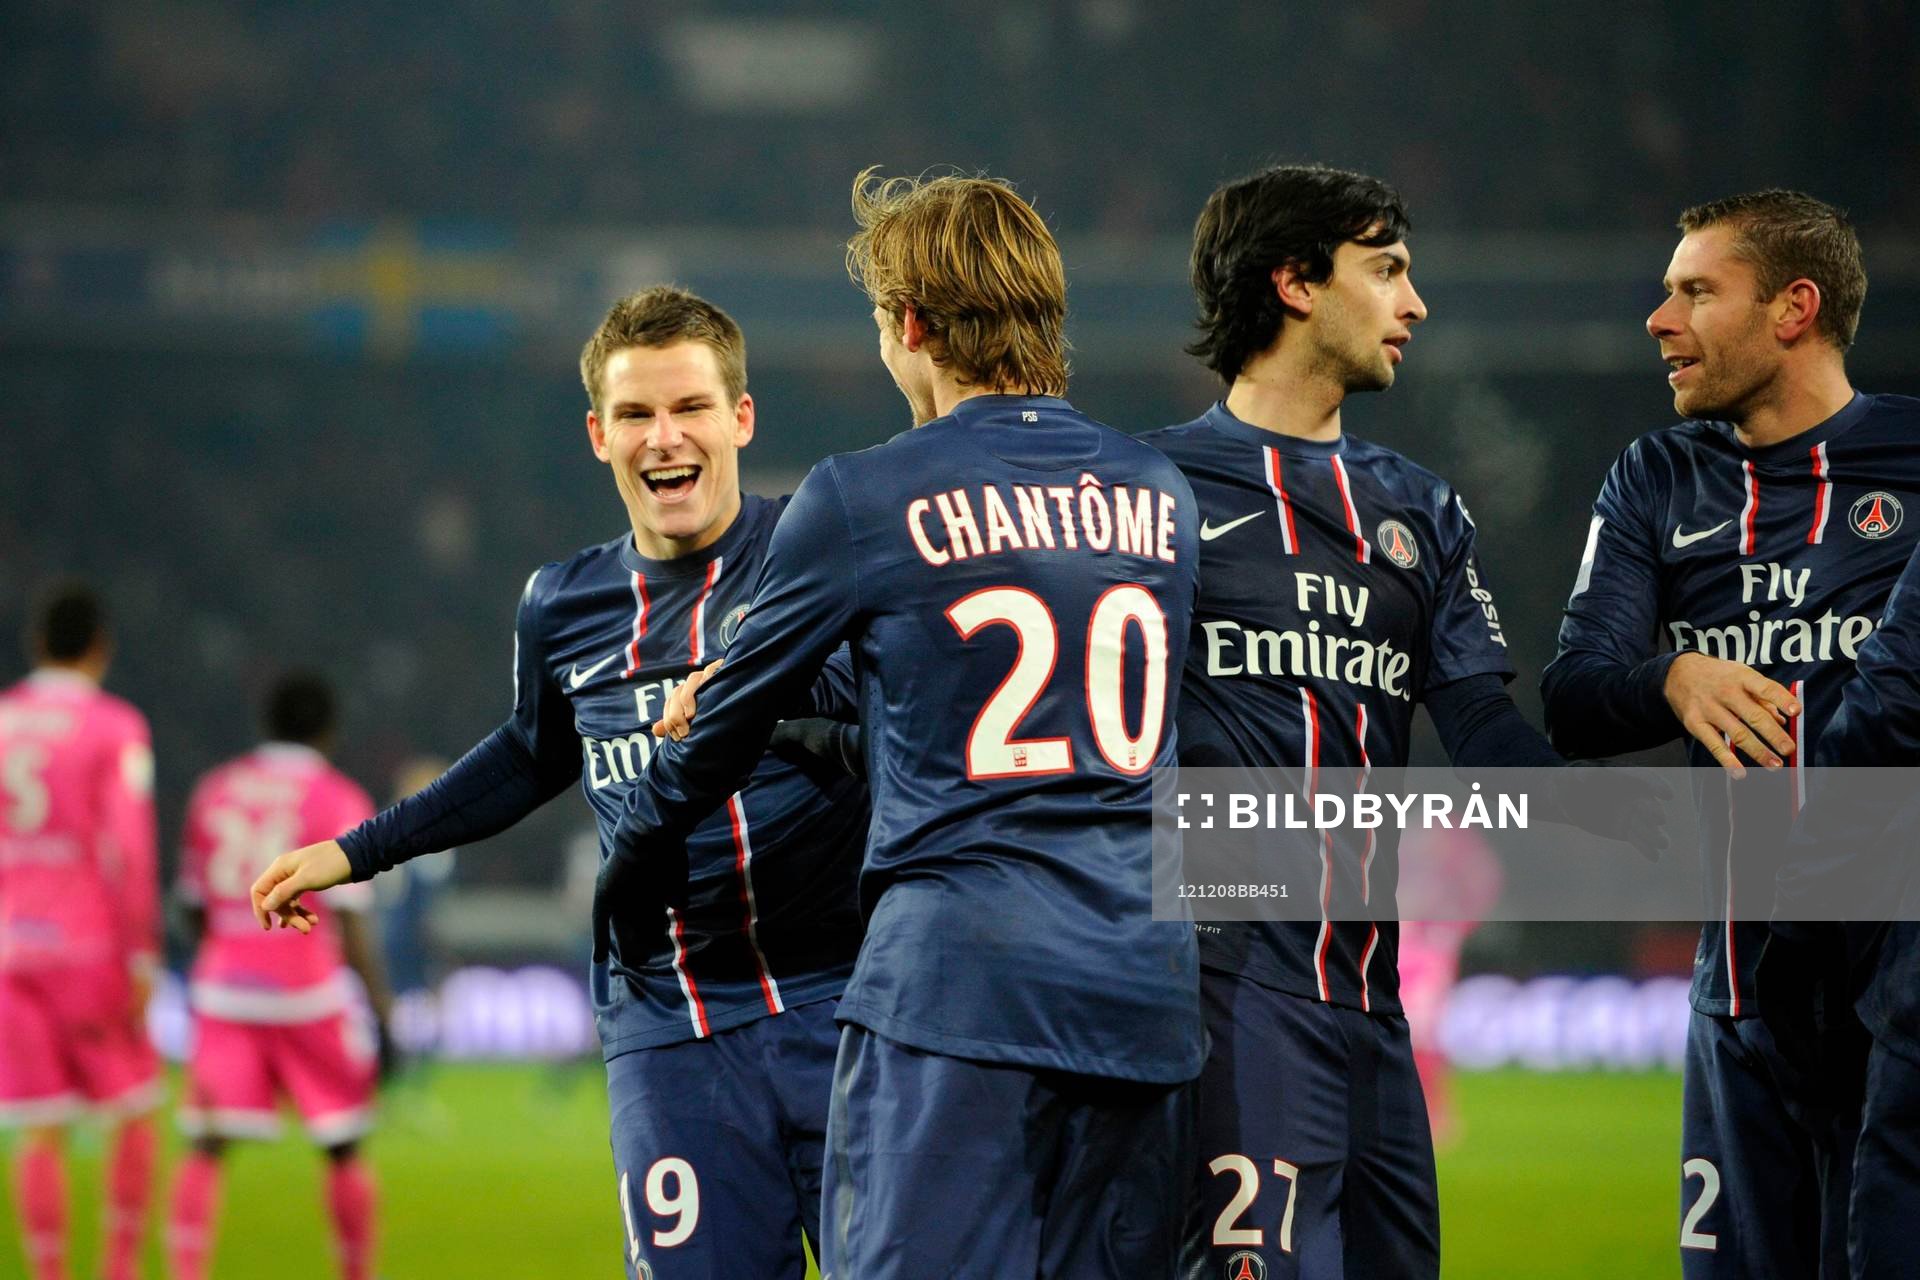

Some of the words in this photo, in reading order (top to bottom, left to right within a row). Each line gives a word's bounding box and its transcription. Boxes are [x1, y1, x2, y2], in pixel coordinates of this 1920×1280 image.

[907, 473, 1177, 568] CHANTÔME
[1294, 571, 1369, 628] Fly
[1738, 562, 1811, 608] Fly
[1201, 619, 1411, 702] Emirate
[1668, 607, 1883, 666] Emirate
[634, 677, 688, 723] Fl
[944, 583, 1169, 781] 20
[1209, 1153, 1299, 1253] 27
[1680, 1157, 1720, 1251] 2
